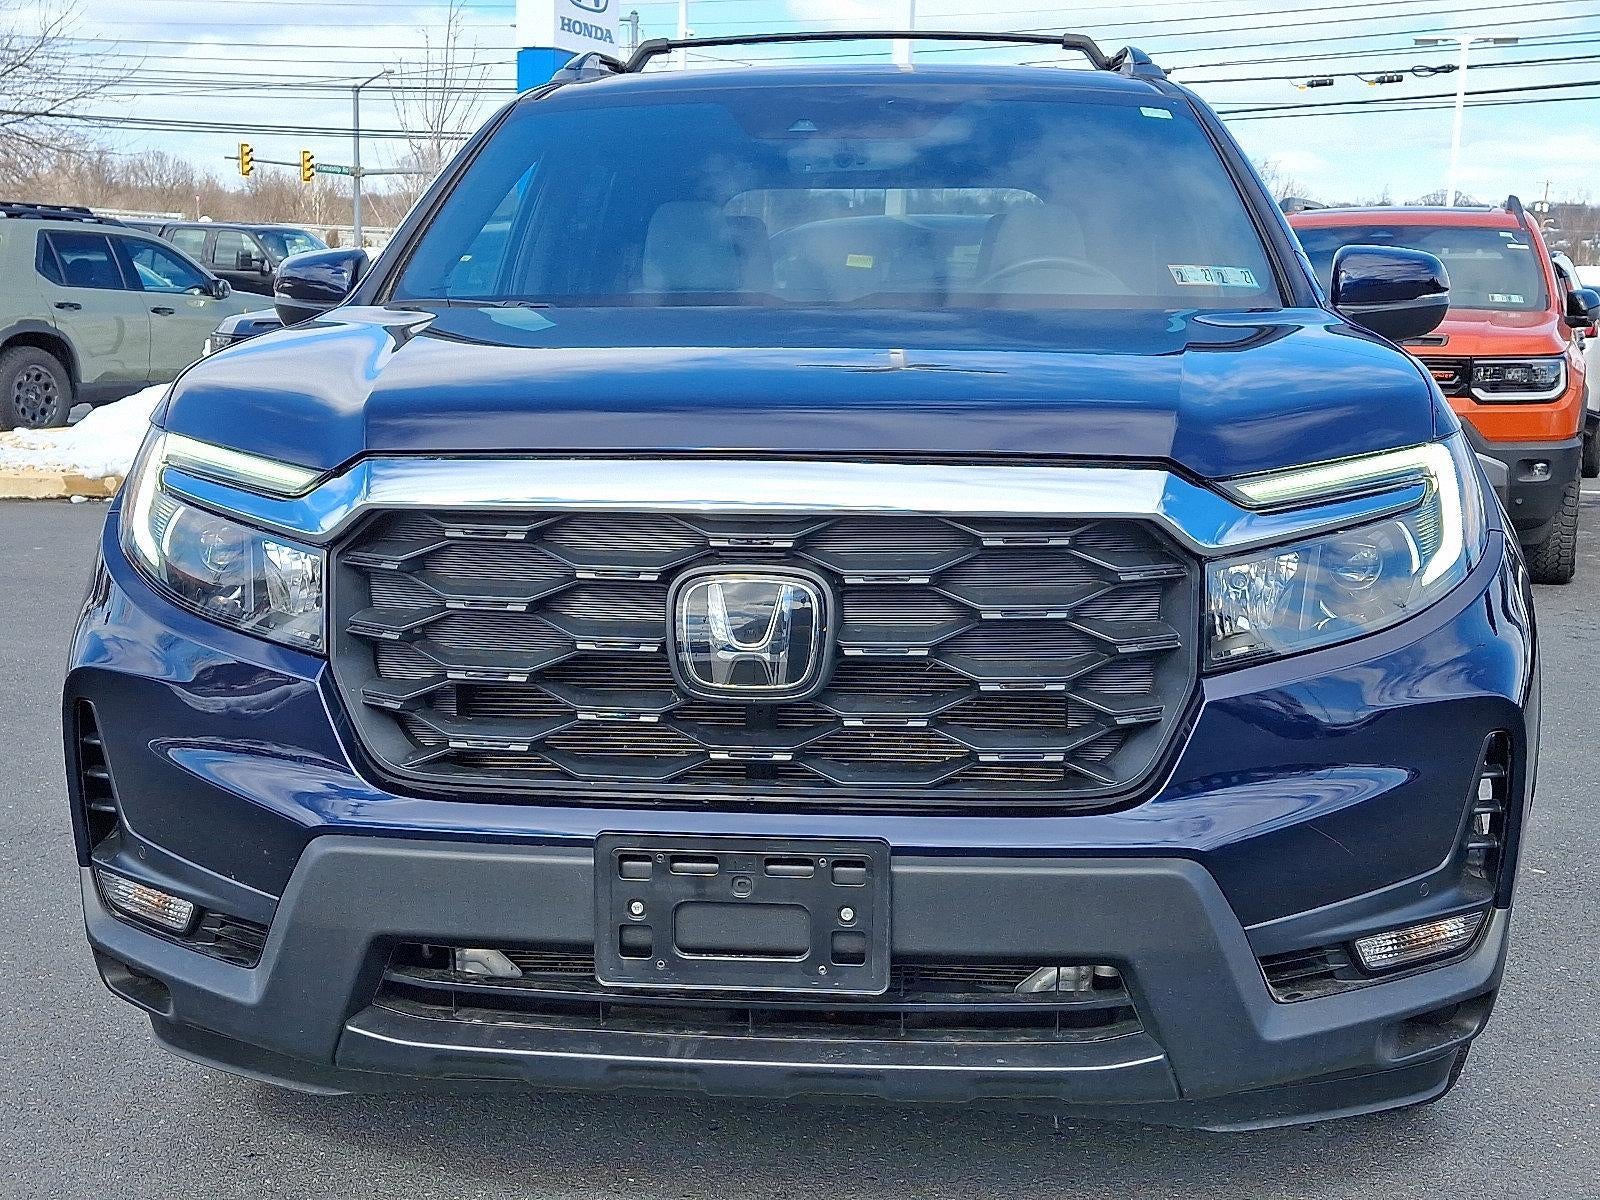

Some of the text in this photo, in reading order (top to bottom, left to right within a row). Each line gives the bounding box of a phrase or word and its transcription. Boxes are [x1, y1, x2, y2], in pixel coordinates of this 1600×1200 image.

[560, 15, 615, 44] HONDA
[1175, 268, 1254, 285] 2 27 2 27
